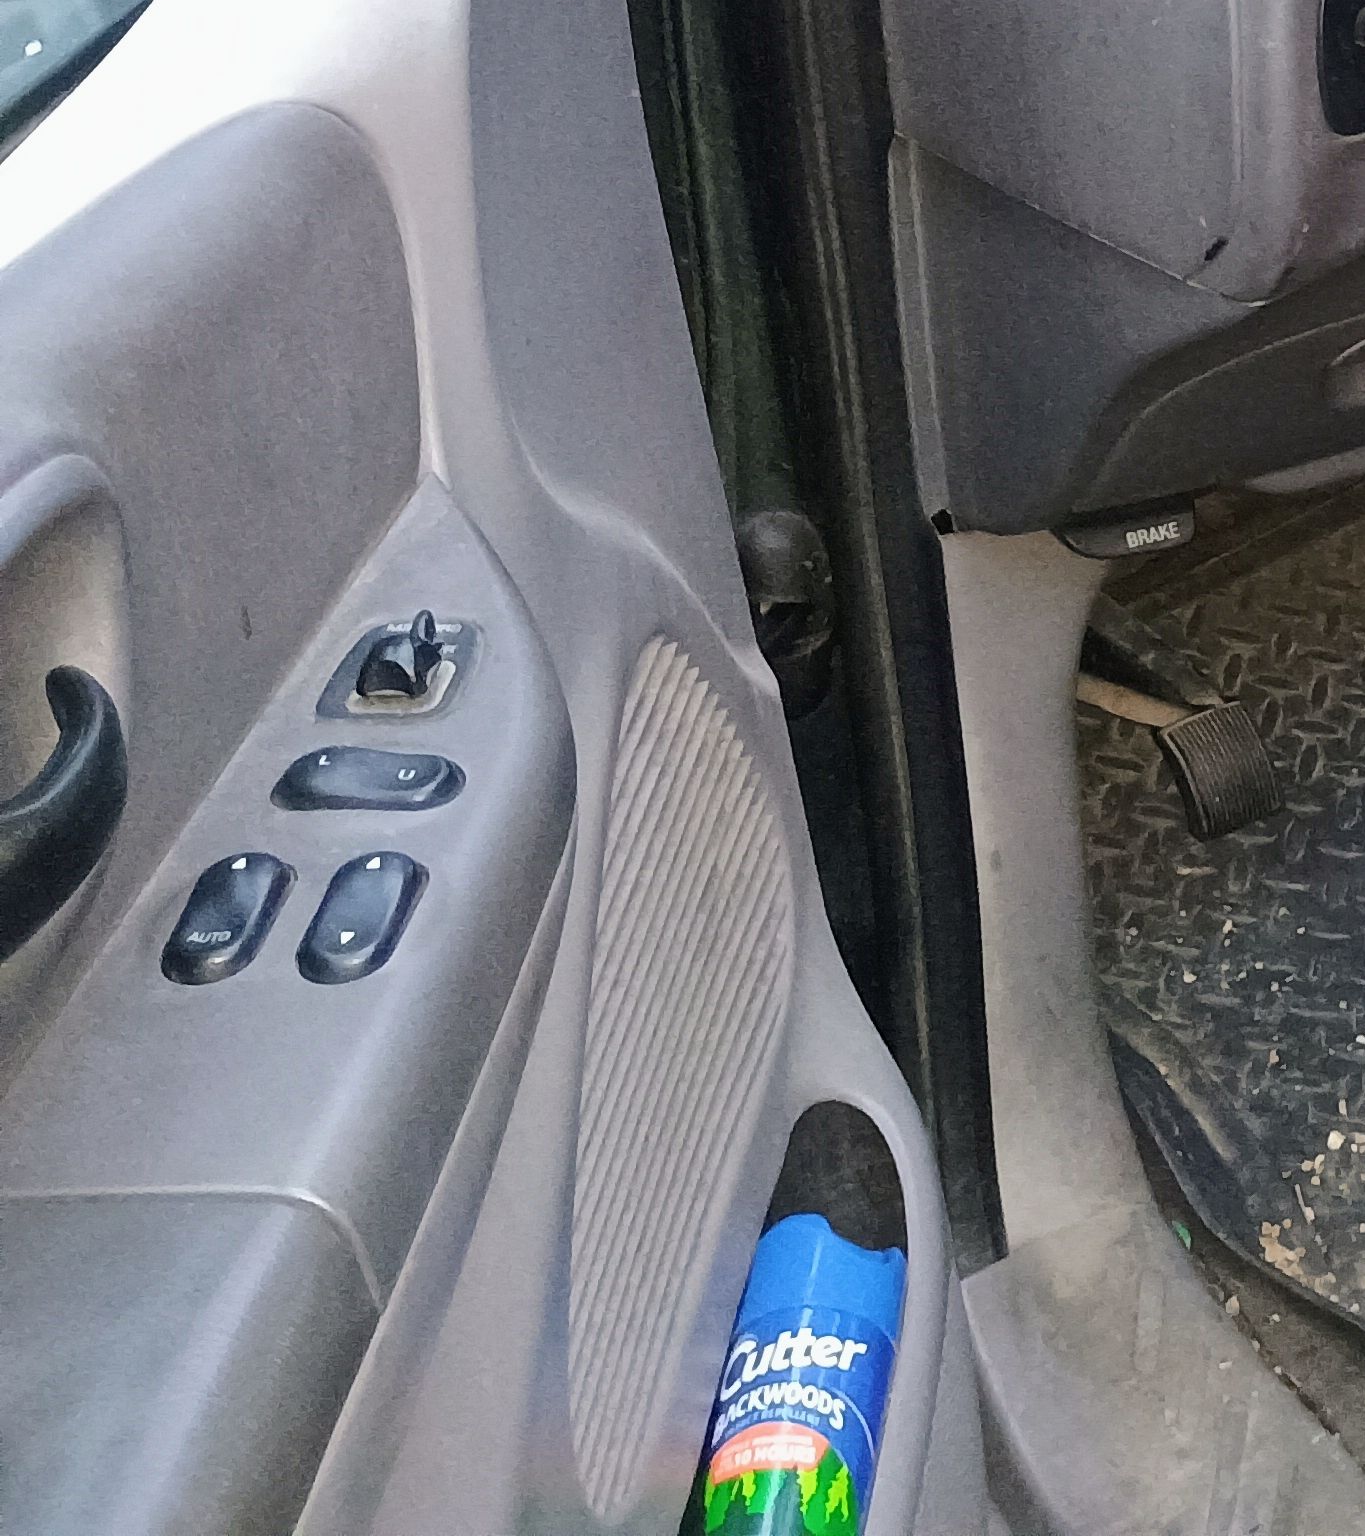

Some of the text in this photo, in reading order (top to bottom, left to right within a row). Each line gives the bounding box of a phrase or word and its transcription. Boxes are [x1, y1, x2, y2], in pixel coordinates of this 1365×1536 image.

[1126, 521, 1181, 549] BRAKE
[319, 754, 331, 766] L
[398, 768, 417, 781] U
[186, 930, 232, 945] AUTO
[719, 1326, 868, 1402] Cutter
[711, 1381, 846, 1449] BACKWOODS
